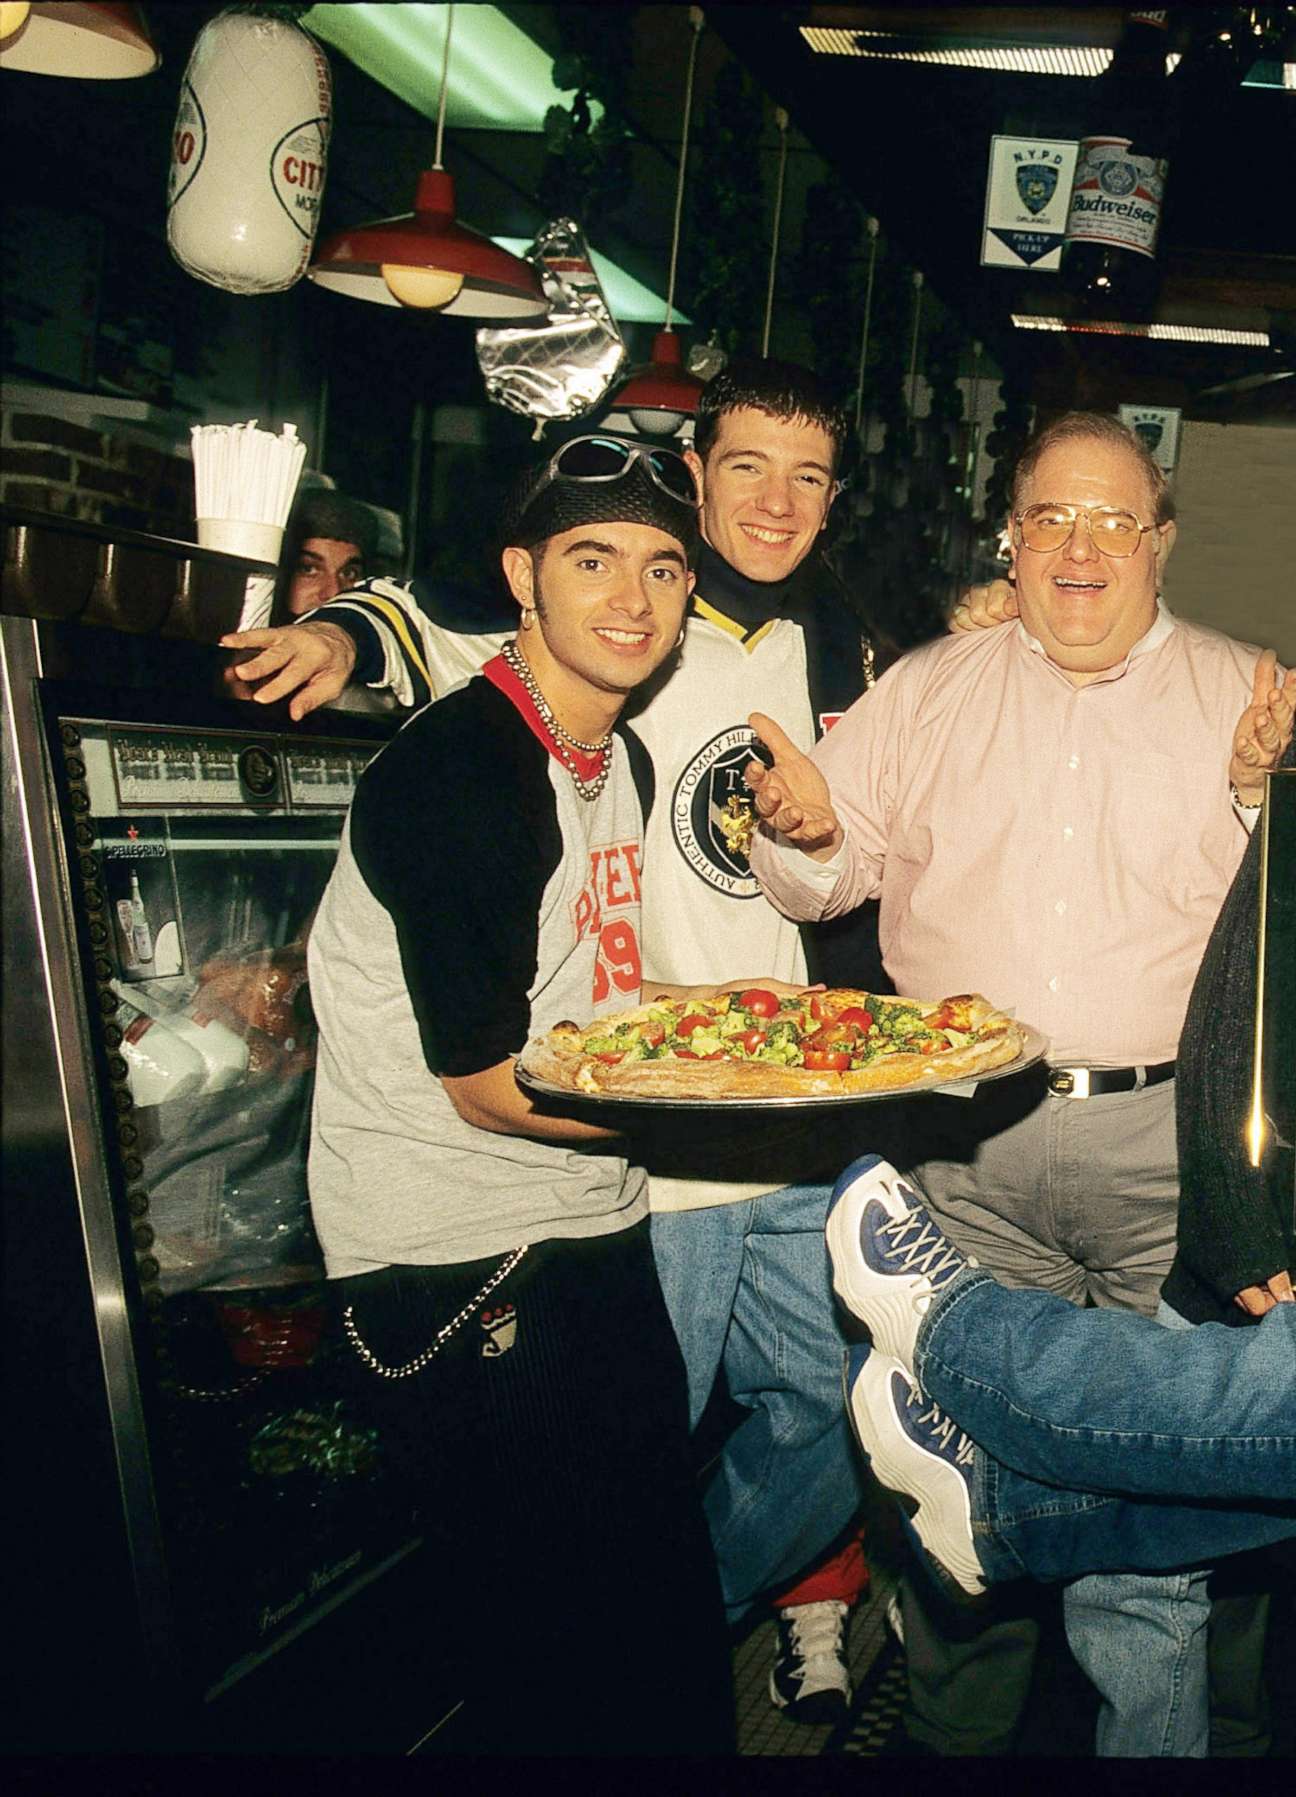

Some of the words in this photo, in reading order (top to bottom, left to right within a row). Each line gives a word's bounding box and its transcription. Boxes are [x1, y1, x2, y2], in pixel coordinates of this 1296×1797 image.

[1072, 194, 1157, 225] Budweiser
[679, 740, 725, 798] TOMMY
[676, 804, 736, 890] AUTHENTIC
